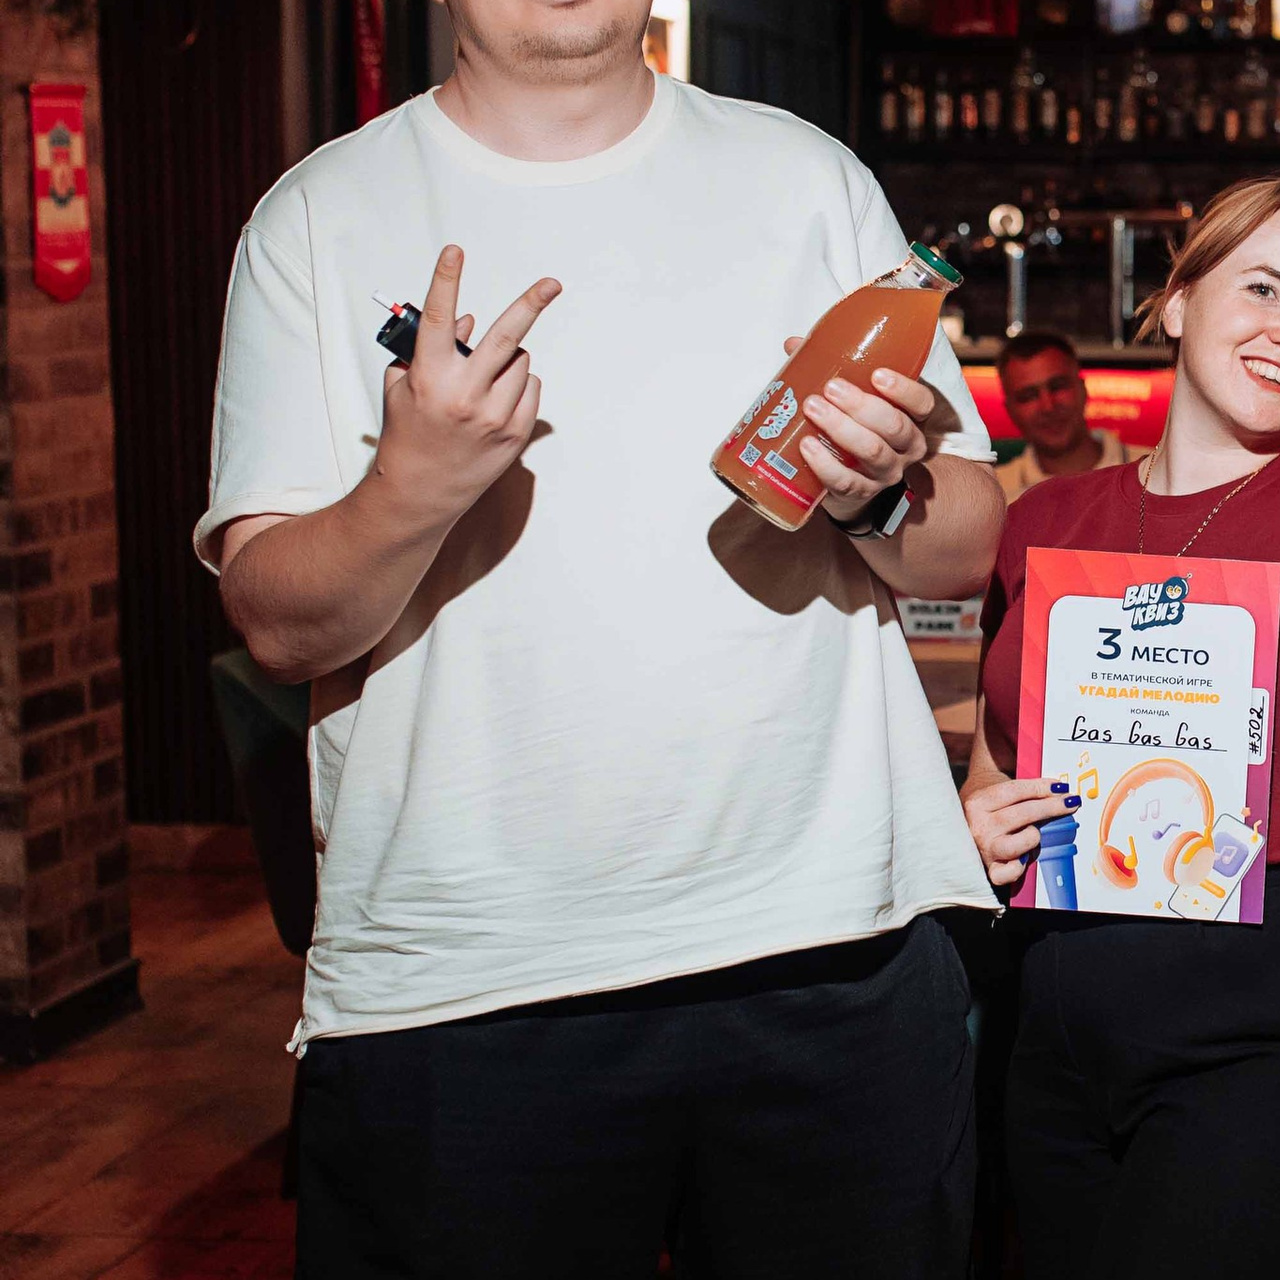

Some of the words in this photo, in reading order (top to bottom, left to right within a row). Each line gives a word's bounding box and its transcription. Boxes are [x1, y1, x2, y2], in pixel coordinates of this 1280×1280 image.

[1124, 583, 1163, 608] ВАУ
[1133, 602, 1180, 626] КВИЗ
[1096, 627, 1122, 660] 3
[1131, 646, 1210, 666] МЕСТО
[1091, 672, 1098, 680] В
[1100, 672, 1184, 686] ТЕМАТИЧЕСКОЙ
[1187, 677, 1213, 688] ИГРЕ
[1078, 685, 1139, 699] УГАДАЙ
[1142, 689, 1220, 704] МЕЛОДИЮ
[1130, 708, 1170, 717] КОМАНДА
[1071, 715, 1112, 742] Gas
[1128, 720, 1162, 747] Gas
[1175, 722, 1213, 750] Gas
[1248, 706, 1264, 754] #502
